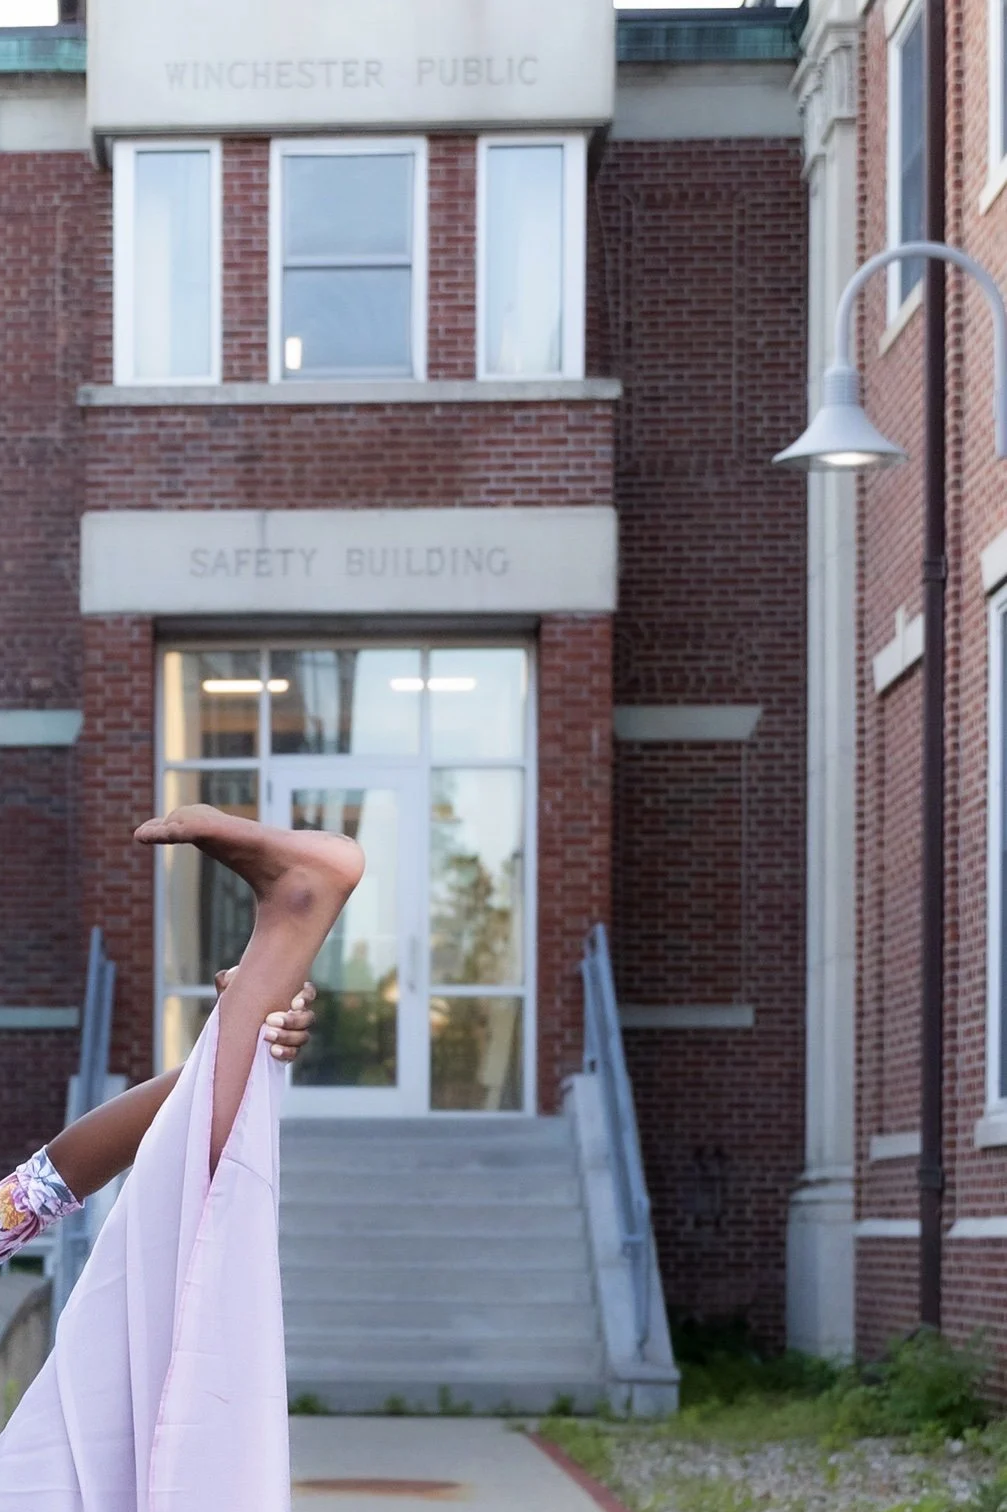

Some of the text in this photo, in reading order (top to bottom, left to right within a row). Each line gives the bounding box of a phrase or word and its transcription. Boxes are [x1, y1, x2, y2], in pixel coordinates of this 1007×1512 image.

[163, 54, 540, 91] WINCHESTER PUBLIC
[189, 545, 511, 578] SAFETY BUILDING
